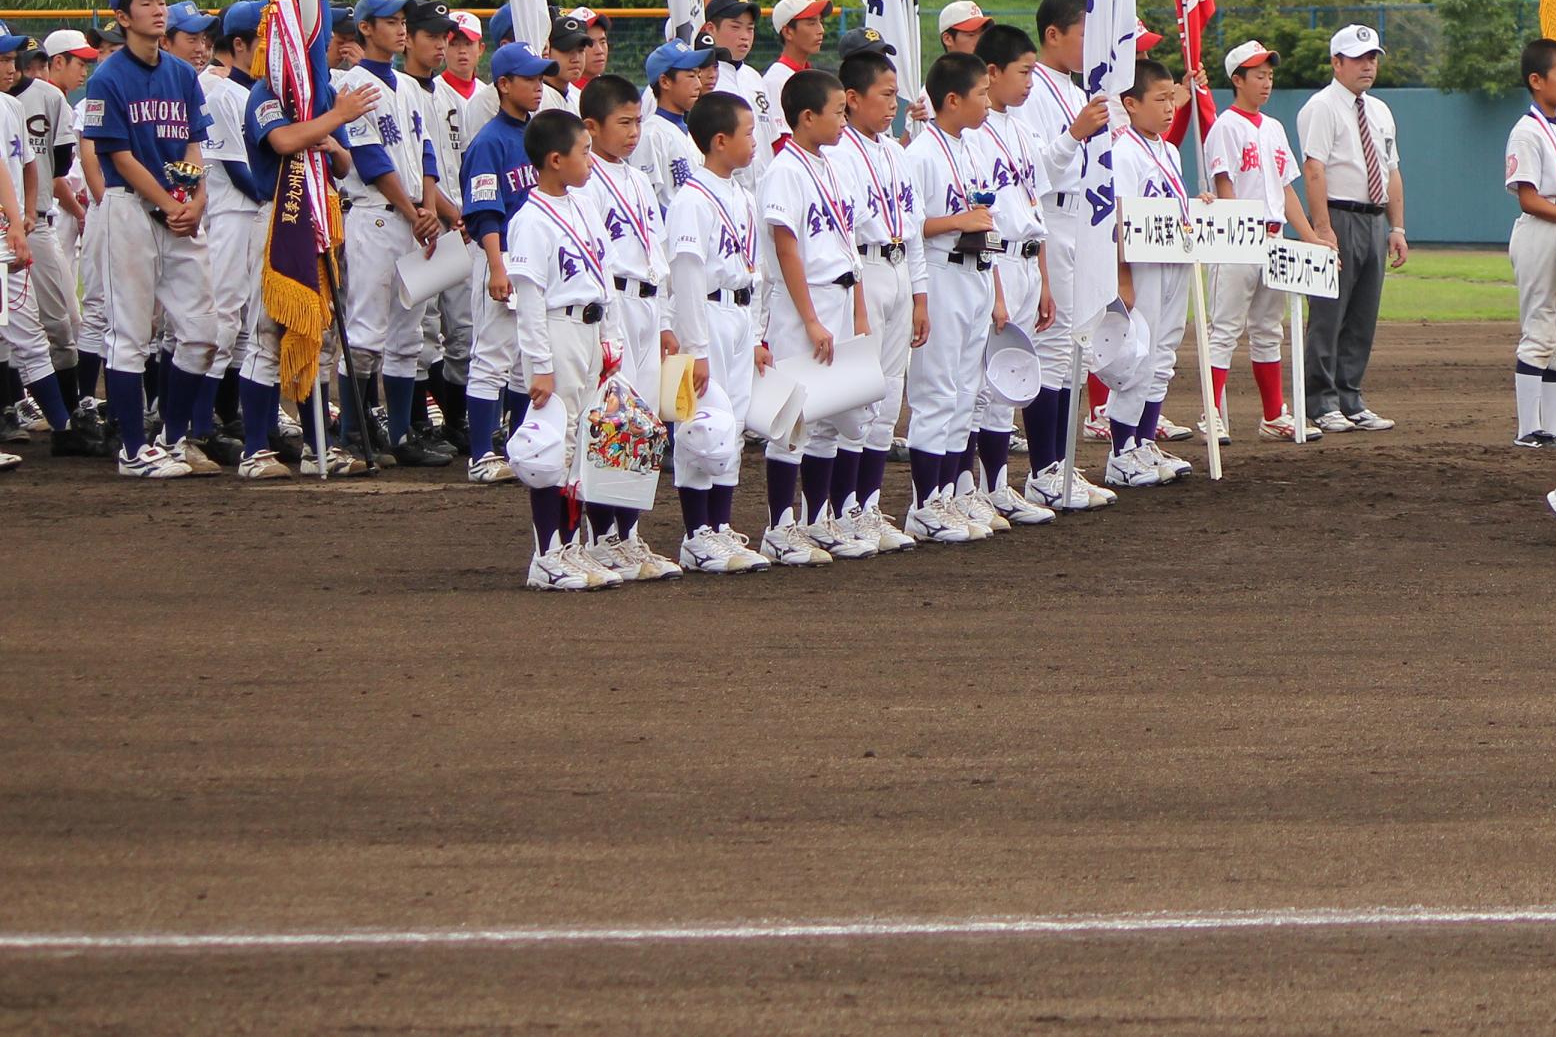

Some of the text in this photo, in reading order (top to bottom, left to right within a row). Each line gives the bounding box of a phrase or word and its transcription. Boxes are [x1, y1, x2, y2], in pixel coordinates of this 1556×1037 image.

[156, 124, 190, 140] WINGS
[506, 164, 540, 192] FUK
[1123, 215, 1265, 246] オール筑紫ベスボールクラブ
